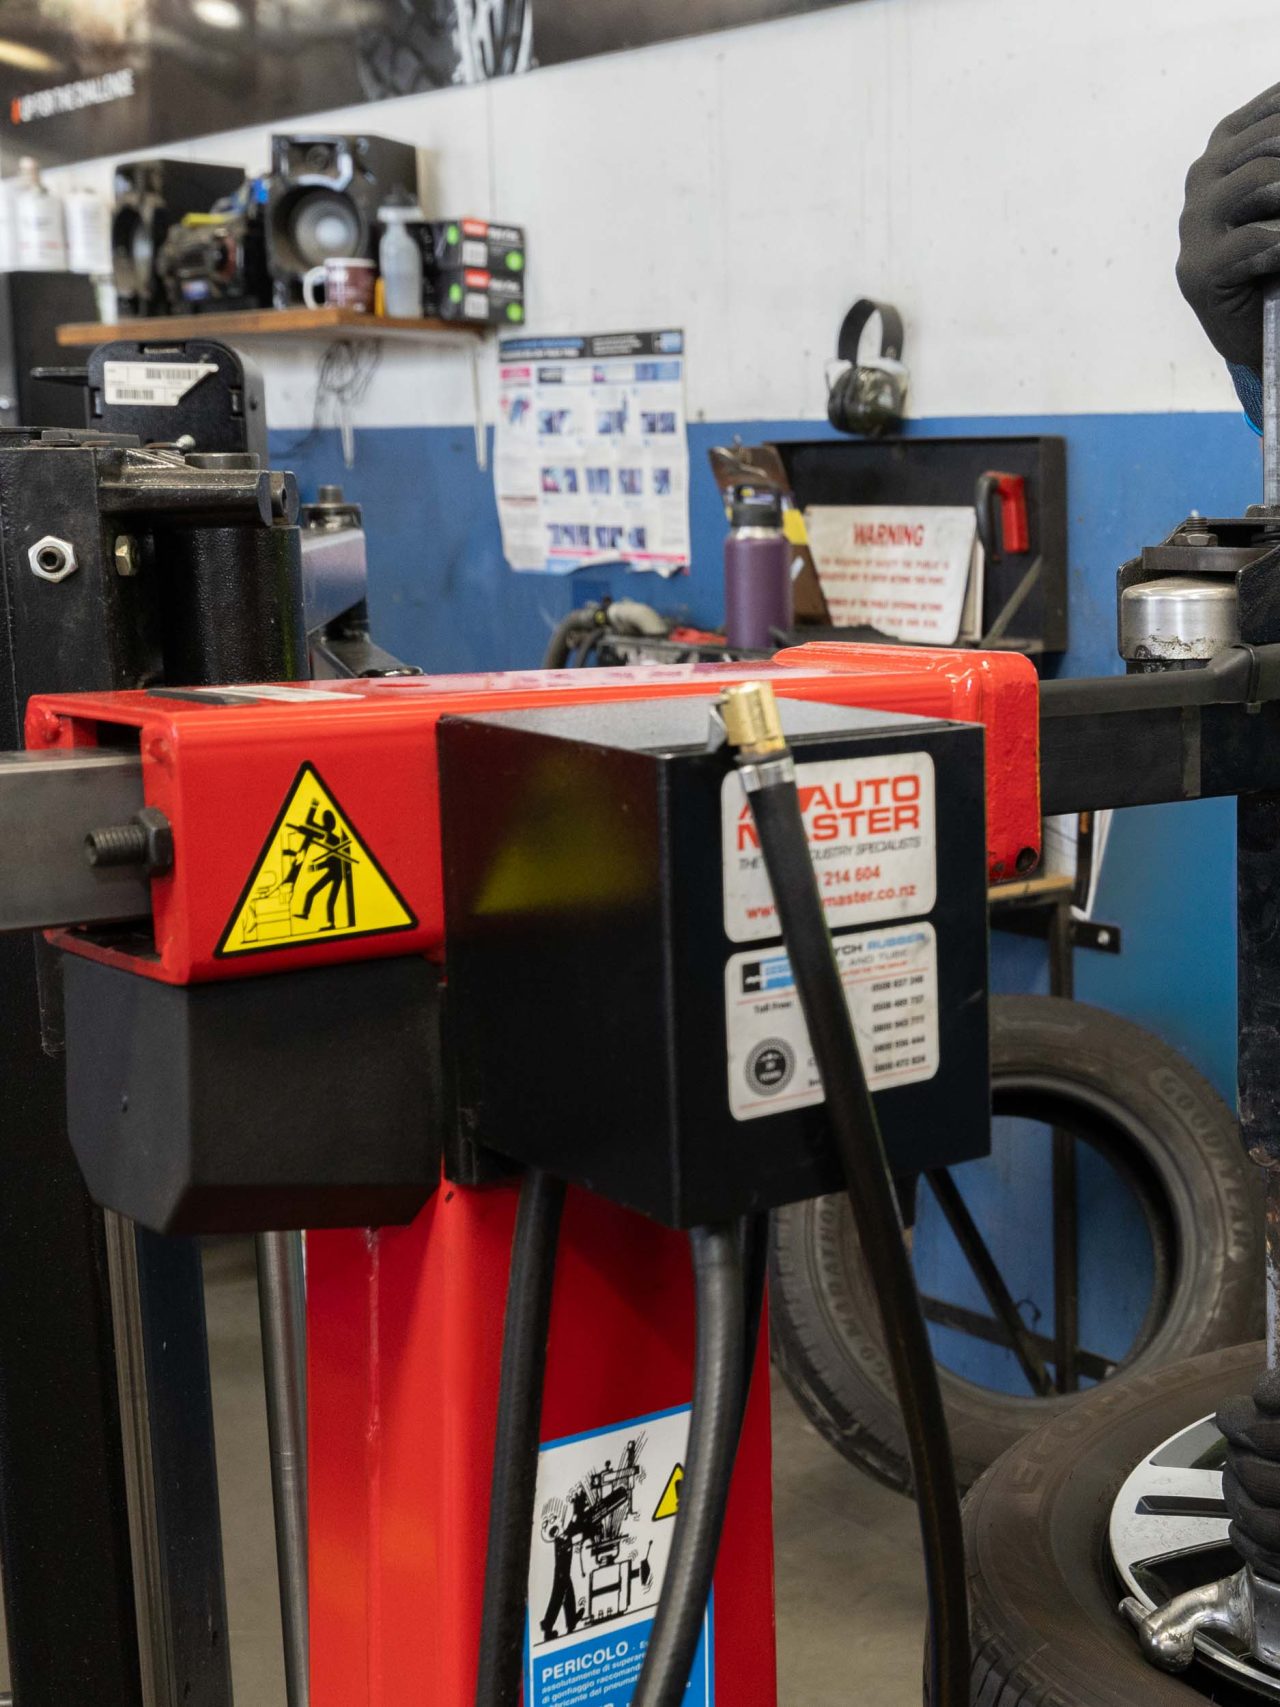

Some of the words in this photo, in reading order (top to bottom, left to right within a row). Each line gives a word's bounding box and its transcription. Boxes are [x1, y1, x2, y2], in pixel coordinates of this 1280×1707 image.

[854, 522, 924, 546] WARNING
[802, 774, 920, 812] AUTO
[737, 804, 919, 851] MSTER
[824, 870, 850, 887] 214
[542, 1641, 628, 1683] PERICOLO
[542, 1668, 601, 1694] assolutamente
[542, 1695, 550, 1705] di
[552, 1681, 594, 1702] gonfiaggio
[596, 1663, 642, 1684] raccomand
[589, 1687, 602, 1698] del
[603, 1674, 638, 1694] pneumat
